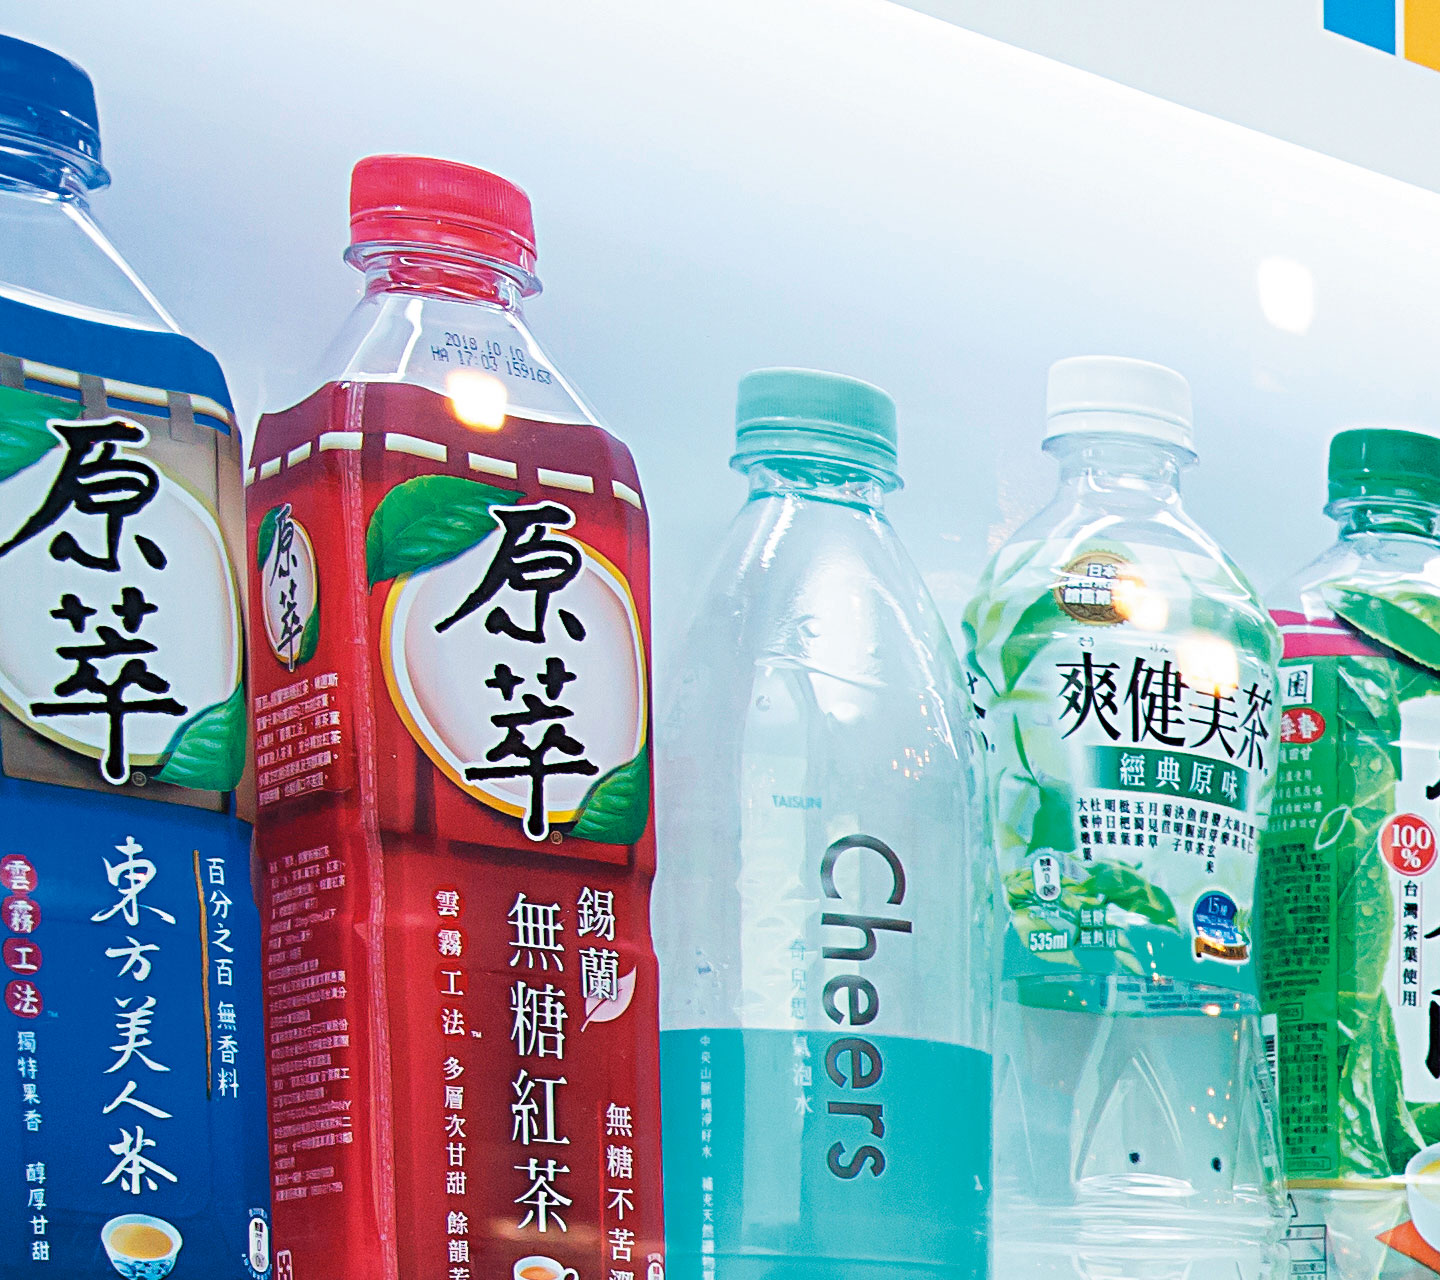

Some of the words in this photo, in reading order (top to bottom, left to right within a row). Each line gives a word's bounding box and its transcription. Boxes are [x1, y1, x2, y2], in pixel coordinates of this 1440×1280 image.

[0, 418, 187, 782] 原萃
[269, 503, 304, 672] 原萃
[436, 503, 599, 838] 原萃
[1119, 752, 1238, 801] 經典原味
[1392, 824, 1431, 849] 100
[206, 857, 235, 987] 百分之百
[1401, 848, 1422, 868] %
[3, 858, 40, 1015] 雲霧工法
[434, 889, 466, 1038] 雲霧工法
[577, 886, 618, 1001] 錫蘭
[1030, 931, 1068, 951] 535ml
[1402, 880, 1418, 1007] 台灣茶葉使用
[90, 836, 178, 1195] 東方美人茶
[217, 1001, 239, 1098] 無香料
[507, 893, 573, 1235] 無糖紅茶
[820, 833, 912, 1180] Cheers
[17, 1030, 42, 1132] 獨特果香
[443, 1057, 466, 1196] 多層次甘甜
[26, 1162, 50, 1262] 醇厚甘甜
